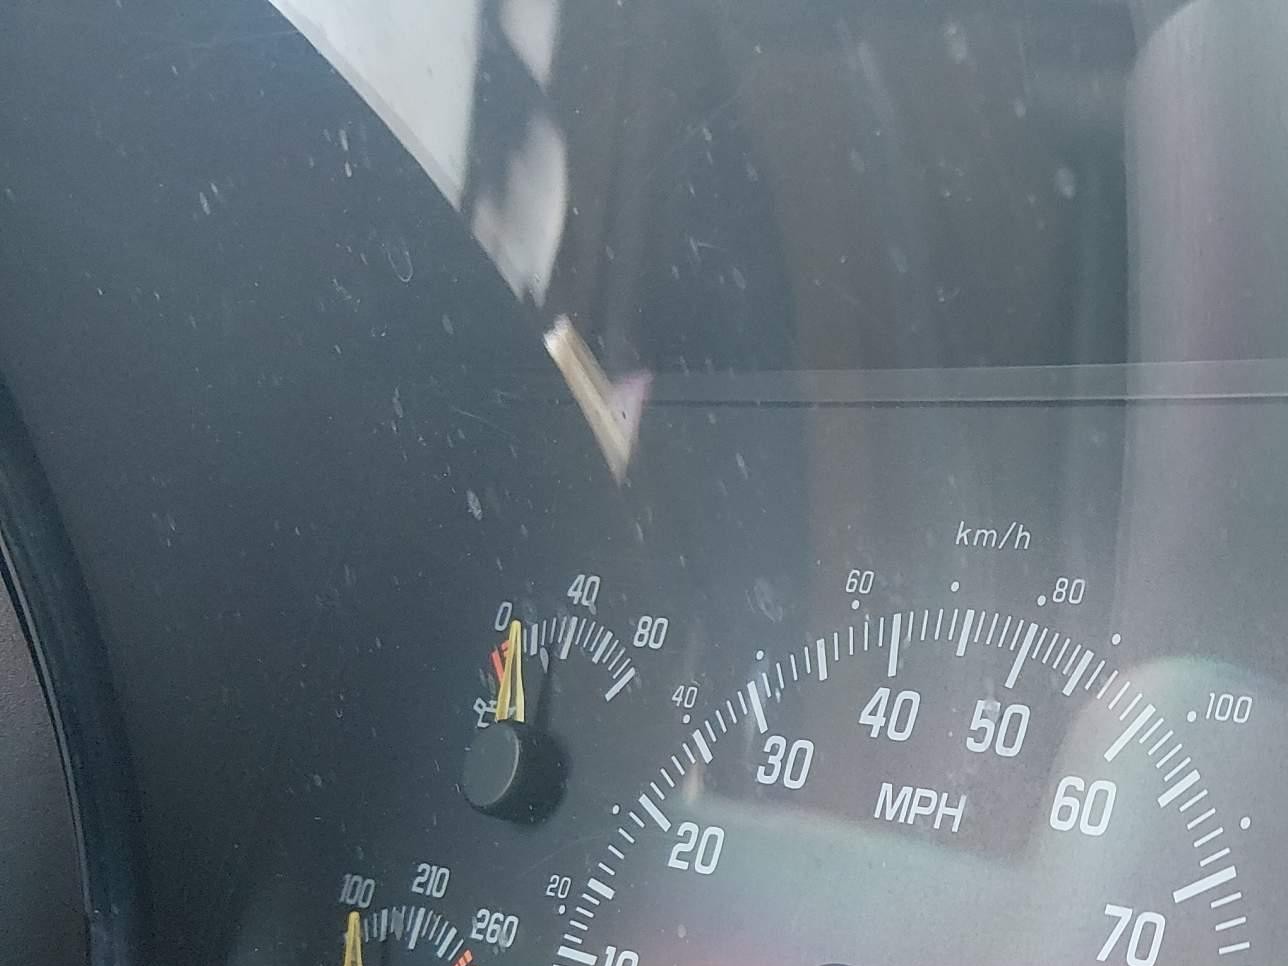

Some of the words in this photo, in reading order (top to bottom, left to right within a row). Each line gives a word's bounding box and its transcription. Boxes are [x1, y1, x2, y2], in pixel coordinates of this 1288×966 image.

[955, 520, 1032, 549] km/h
[567, 574, 600, 606] 40
[846, 569, 874, 594] 60
[1052, 577, 1086, 604] 80
[494, 601, 512, 631] 0
[633, 615, 669, 649] 80
[671, 685, 698, 708] 40
[1205, 692, 1253, 723] 100
[858, 687, 921, 741] 40
[966, 700, 1031, 757] 50
[756, 735, 814, 789] 30
[873, 782, 967, 833] MPH
[1049, 776, 1117, 836] 60
[668, 822, 725, 874] 20
[338, 873, 376, 908] 100
[412, 862, 450, 898] 210
[546, 874, 571, 899] 20
[469, 908, 519, 948] 260
